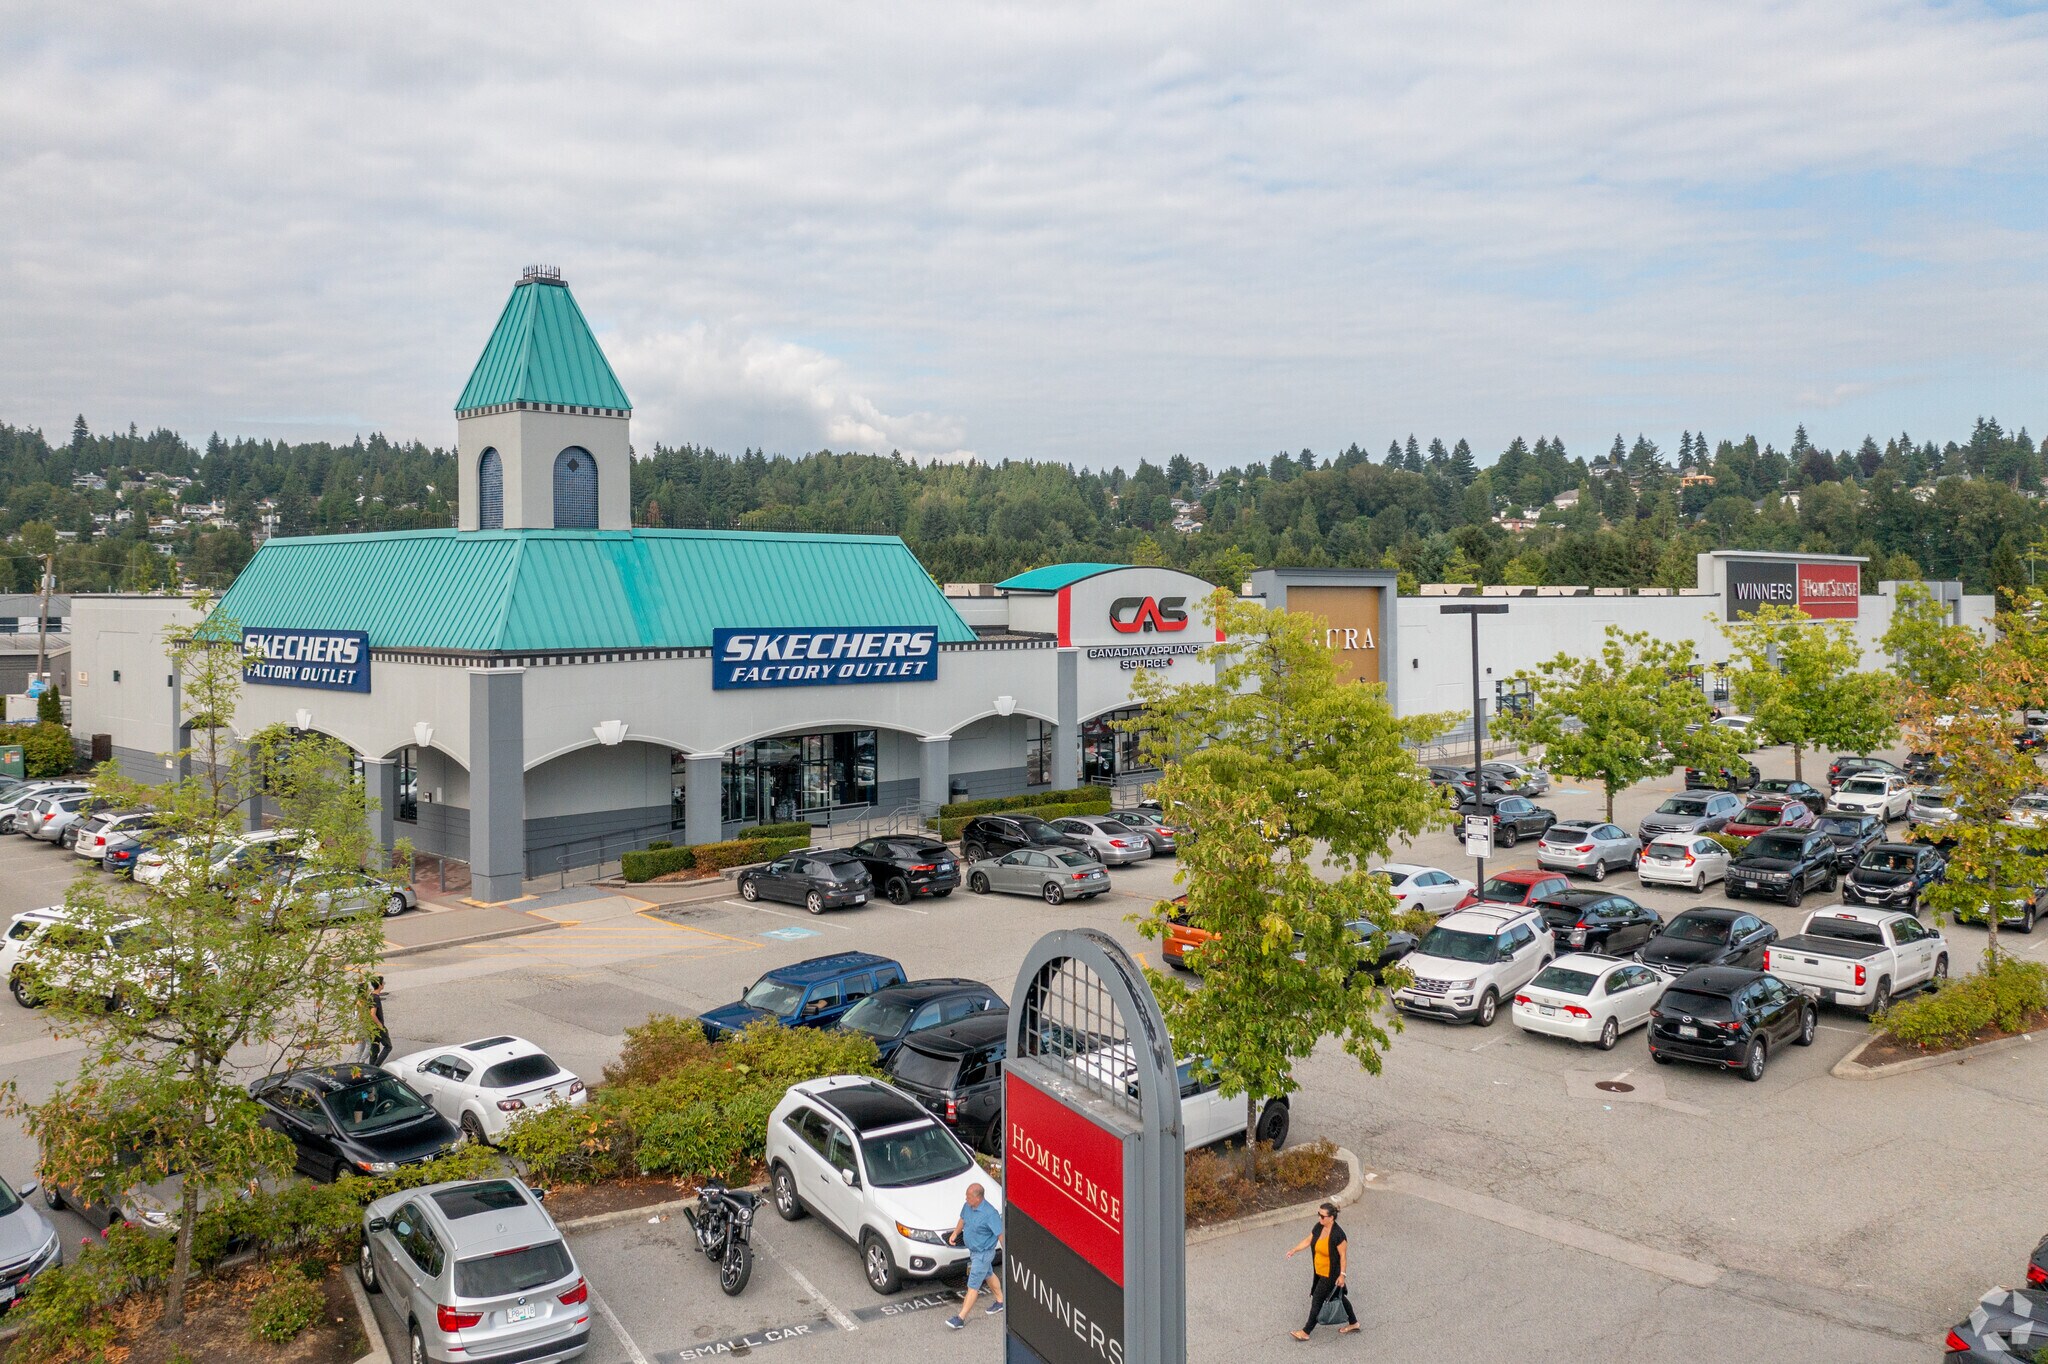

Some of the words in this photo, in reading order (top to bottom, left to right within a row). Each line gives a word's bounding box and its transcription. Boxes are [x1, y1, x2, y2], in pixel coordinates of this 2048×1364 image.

[1736, 583, 1793, 600] WINNERS
[1109, 596, 1188, 633] CAS
[243, 634, 360, 663] SKECHERS
[722, 632, 934, 662] SKECHERS
[1088, 647, 1147, 660] CANADIAN
[247, 664, 299, 680] FACTORY
[300, 667, 356, 684] OUTLET
[730, 664, 835, 682] FACTORY
[838, 661, 927, 677] OUTLET
[1121, 659, 1168, 670] SOURCE
[880, 1294, 948, 1316] SMALL
[1010, 1254, 1123, 1364] WINNERS
[679, 1337, 762, 1360] SMALL
[764, 1324, 813, 1342] CAR
